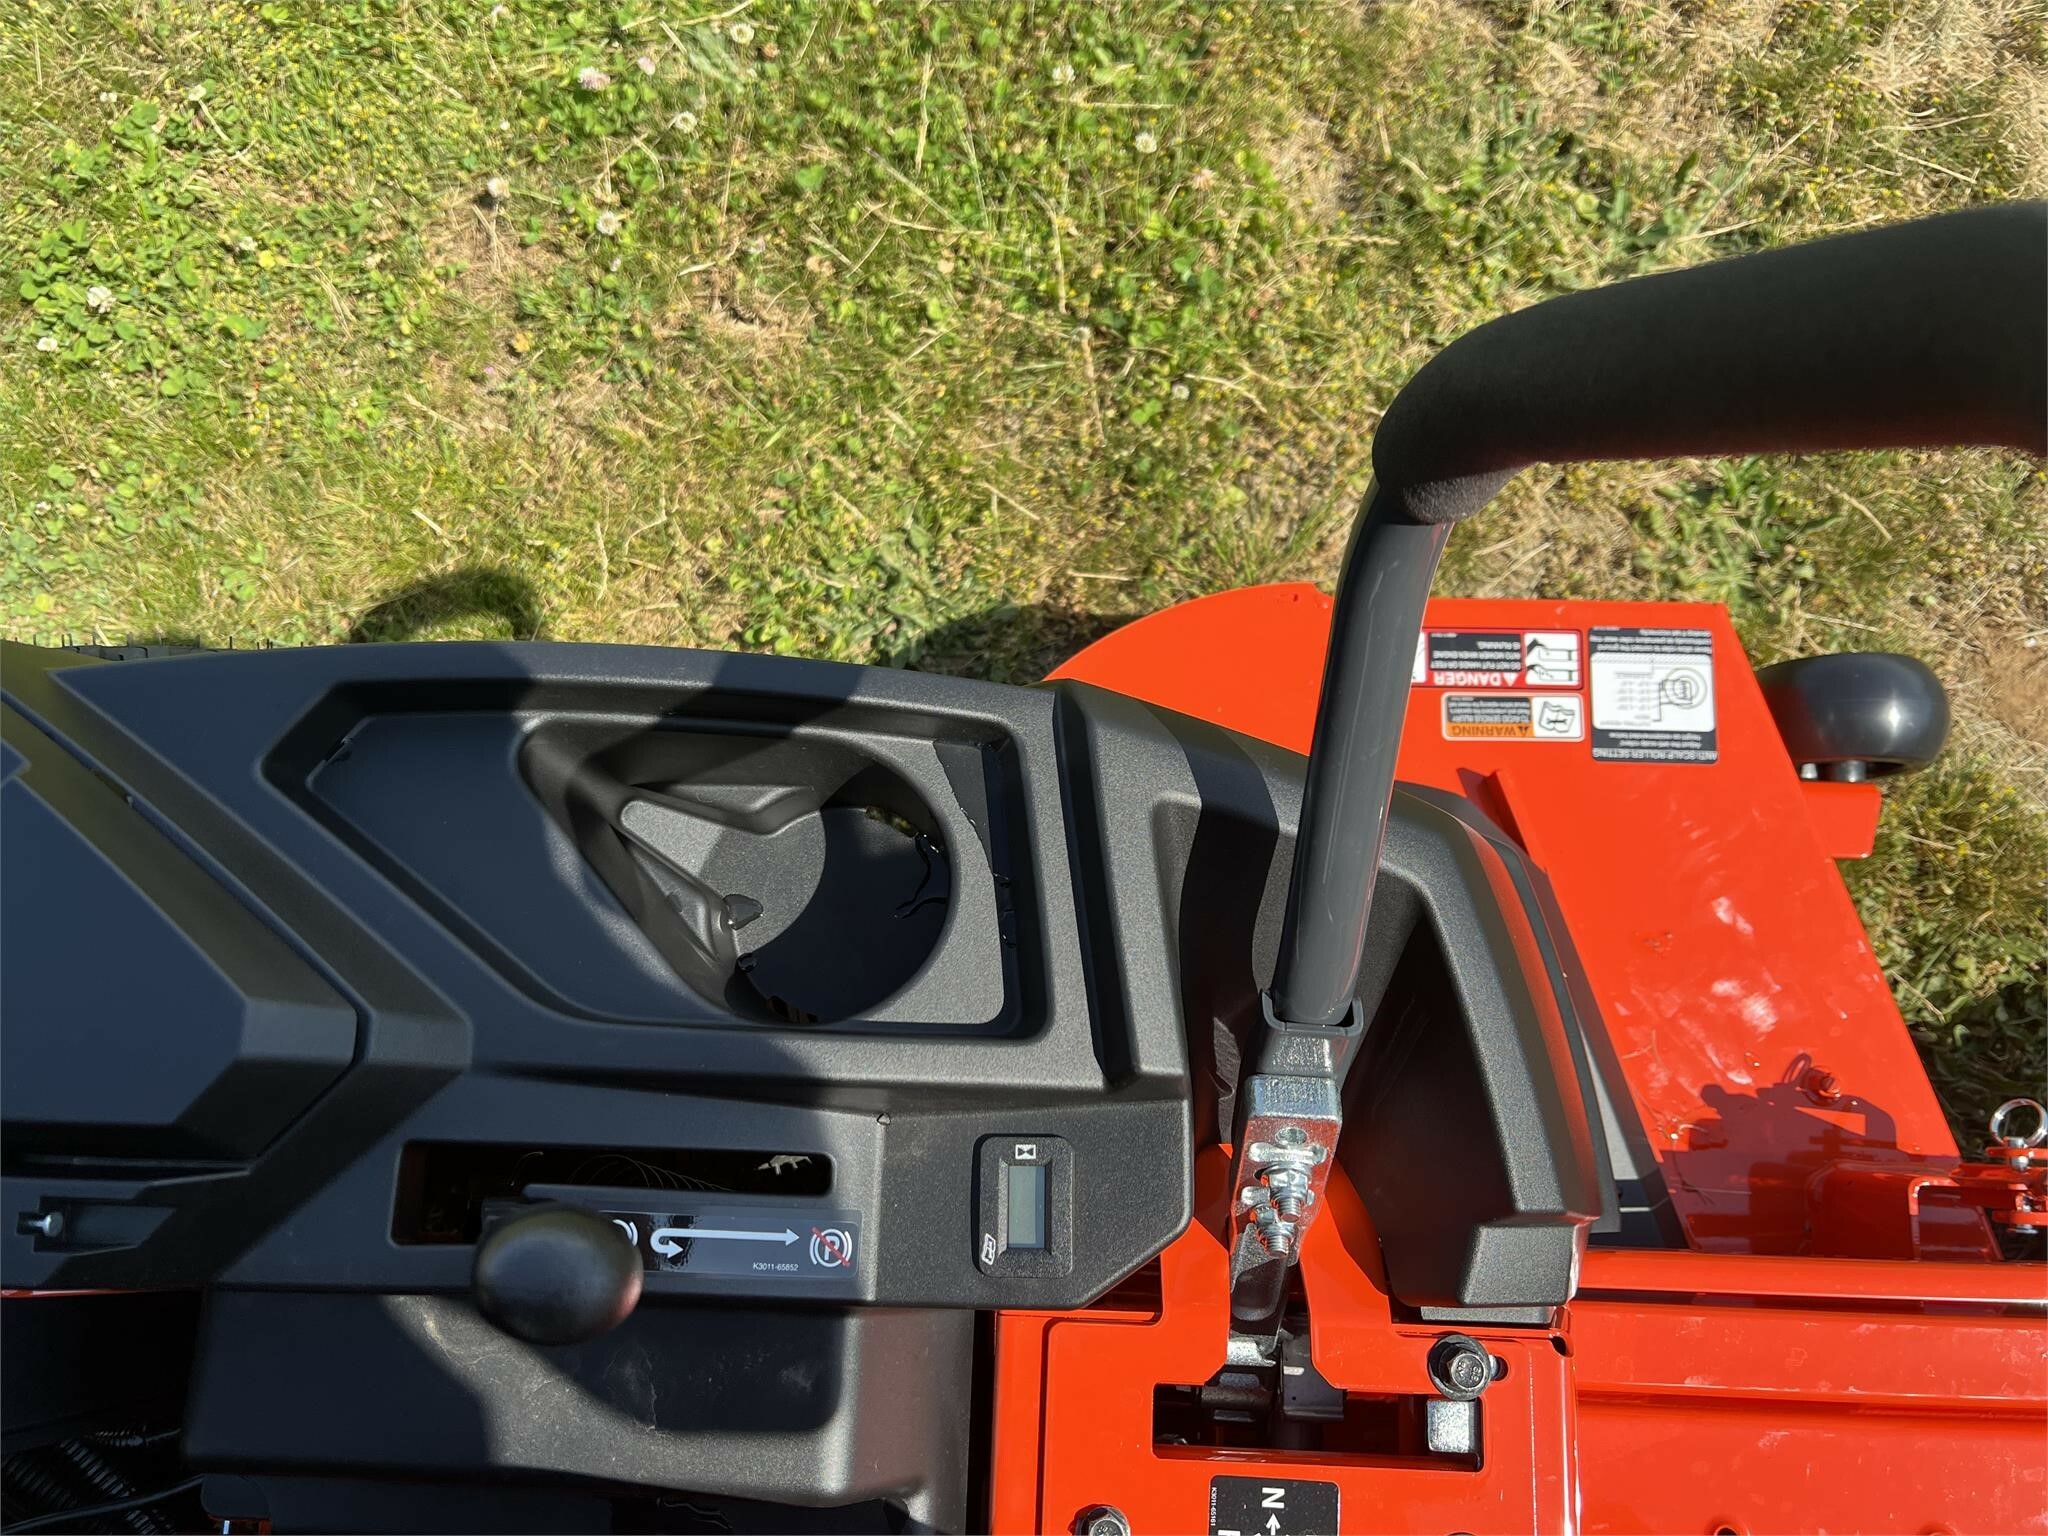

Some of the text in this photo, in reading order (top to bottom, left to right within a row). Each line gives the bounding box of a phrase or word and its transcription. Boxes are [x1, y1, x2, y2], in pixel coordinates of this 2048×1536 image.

[1434, 672, 1501, 686] DANGER
[1452, 725, 1517, 736] WARNING
[1261, 1487, 1285, 1509] N
